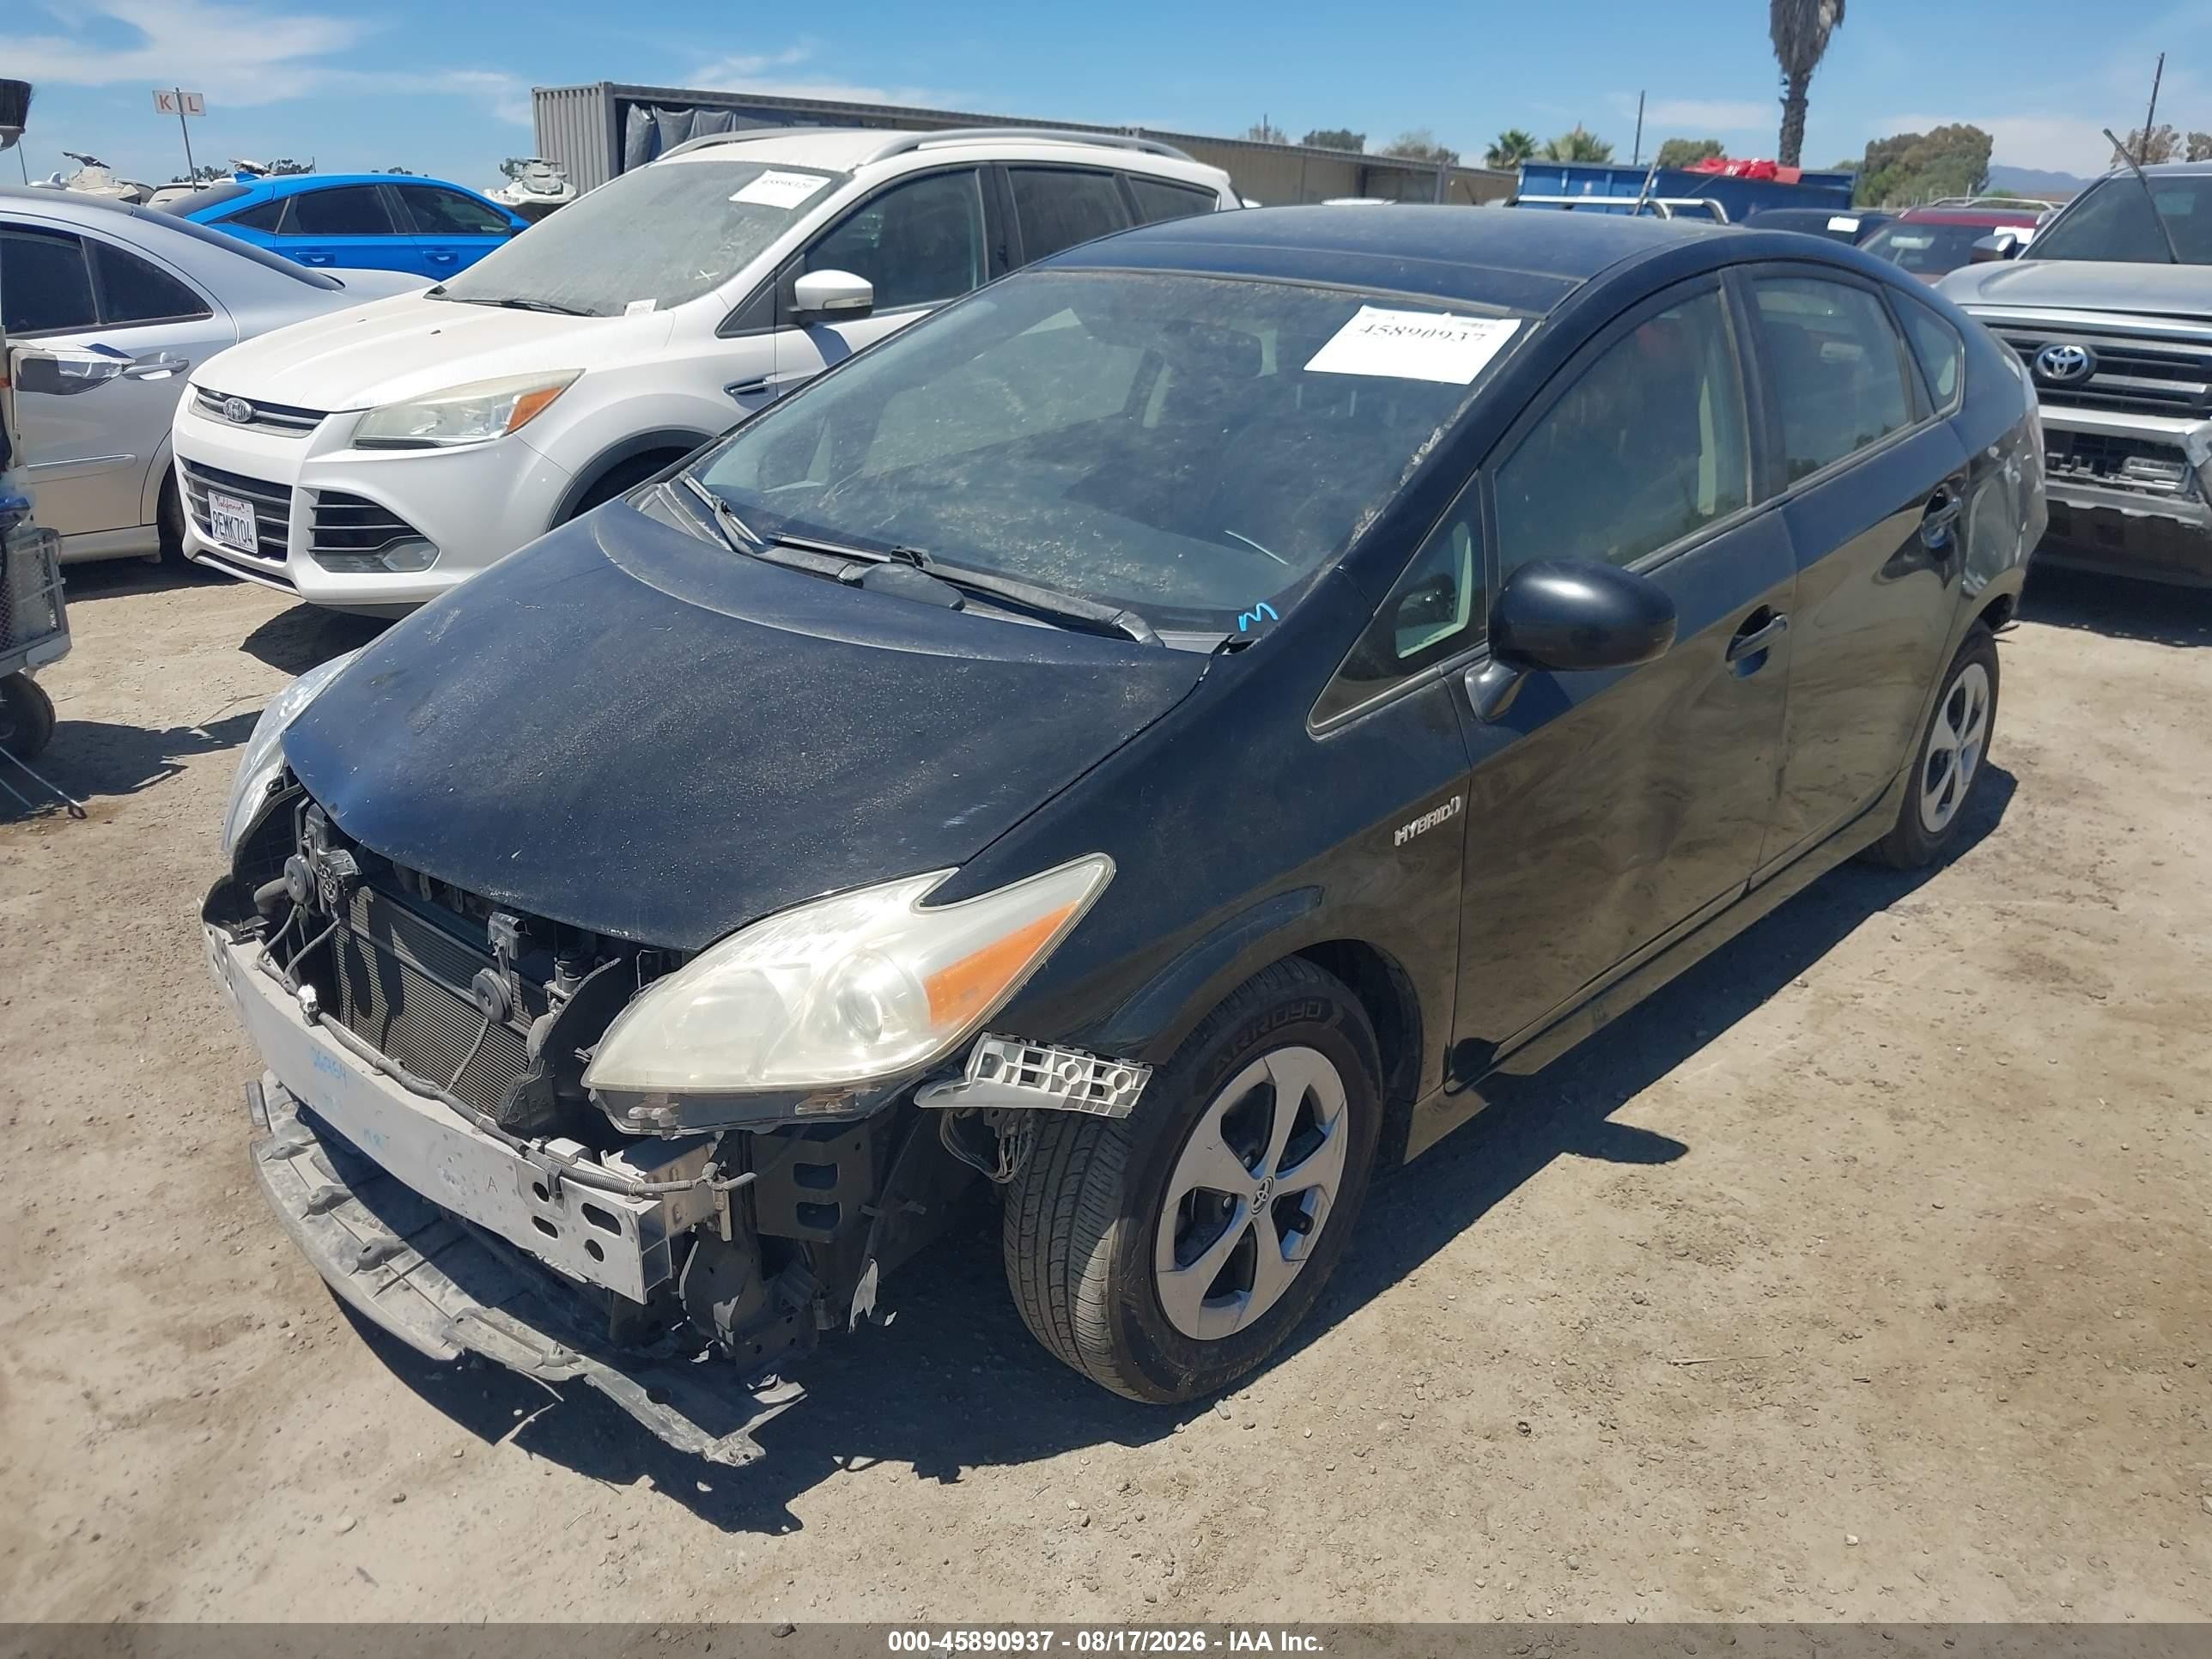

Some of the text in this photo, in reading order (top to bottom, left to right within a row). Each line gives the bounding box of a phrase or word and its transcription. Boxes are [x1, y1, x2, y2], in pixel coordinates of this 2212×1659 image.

[159, 94, 172, 110] K
[187, 96, 199, 112] L
[1359, 323, 1487, 342] 45890937
[212, 510, 253, 546] 9EMK704
[1394, 795, 1461, 847] HYBRID
